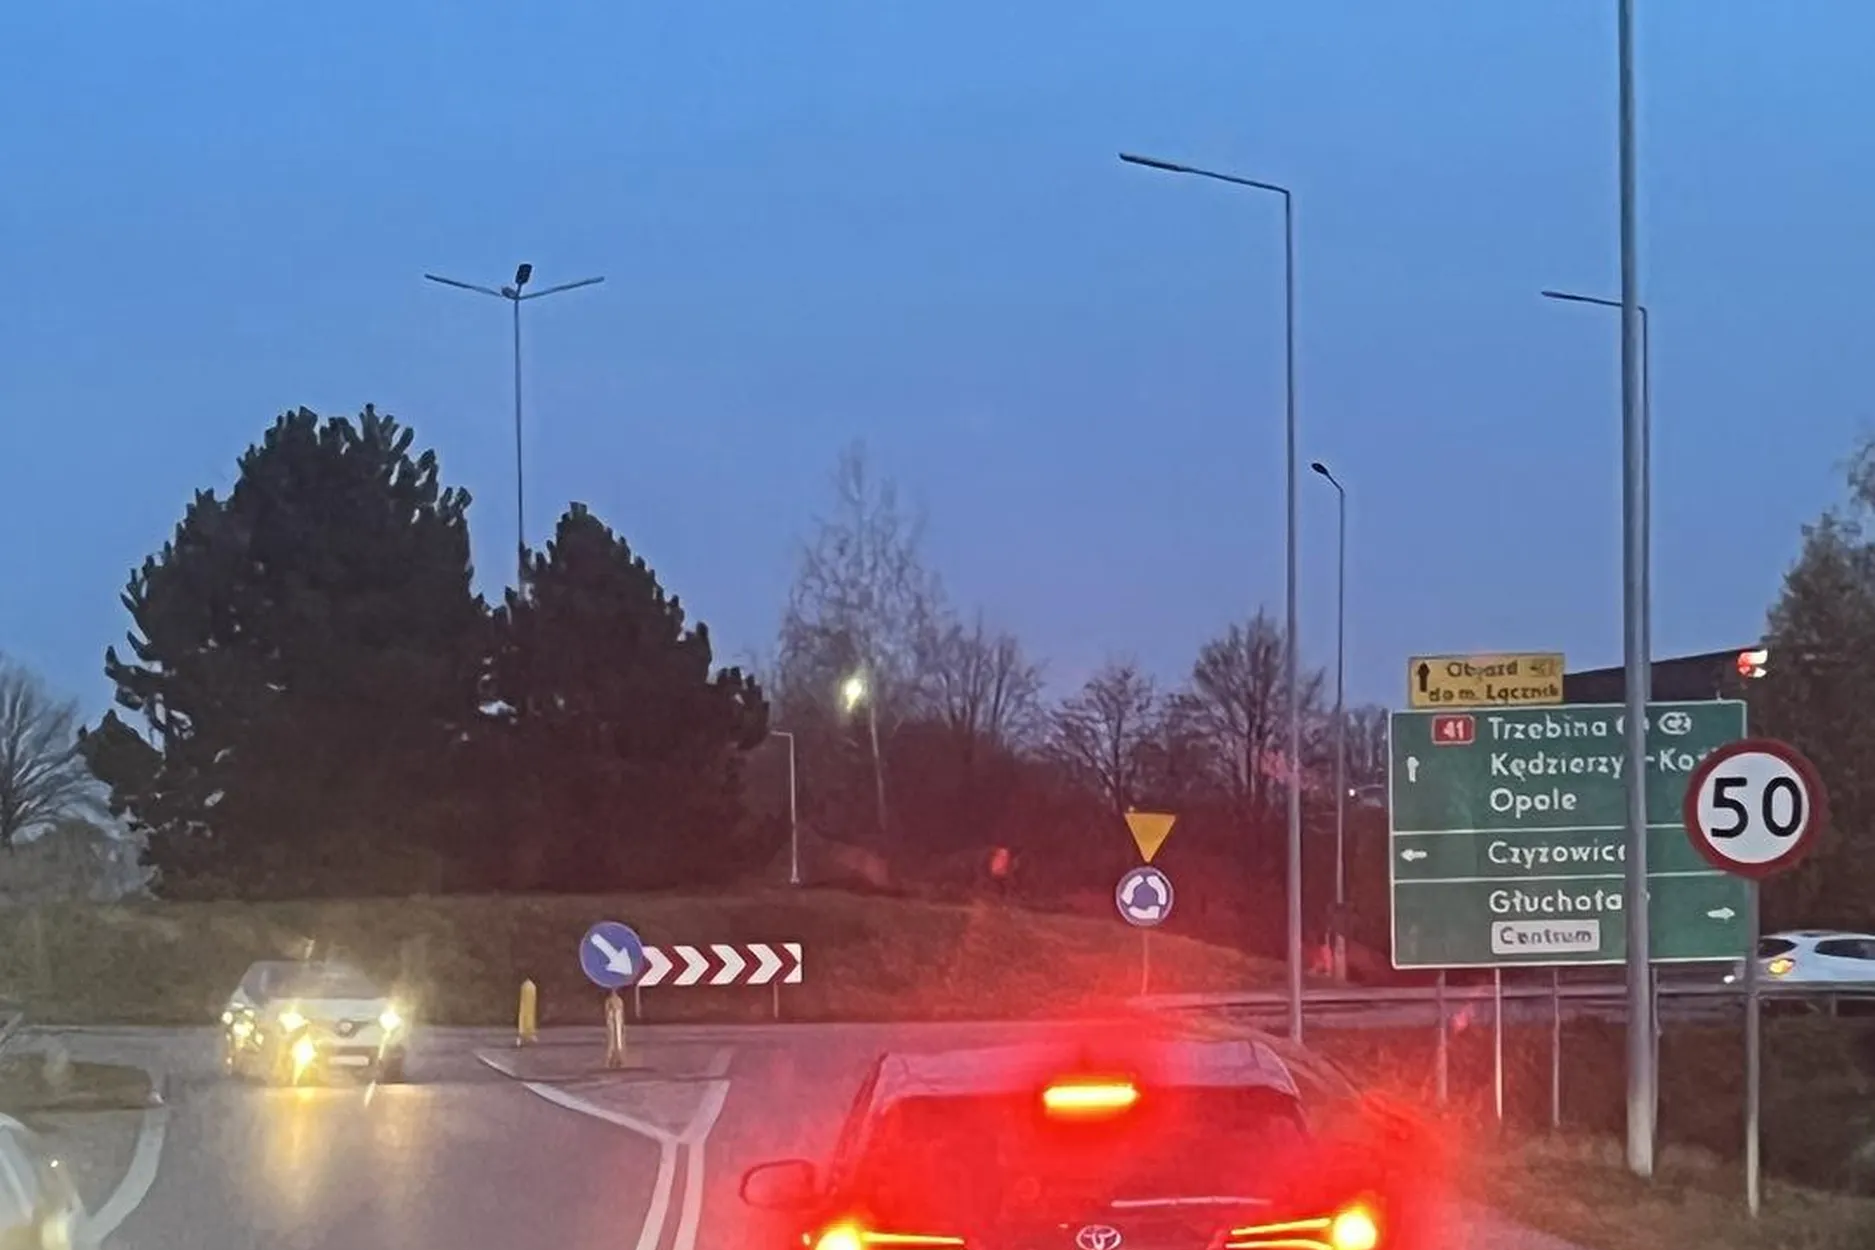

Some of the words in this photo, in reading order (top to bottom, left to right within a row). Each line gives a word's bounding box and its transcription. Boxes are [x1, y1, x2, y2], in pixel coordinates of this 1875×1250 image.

[1442, 720, 1465, 740] 41
[1490, 787, 1578, 819] Opole
[1710, 776, 1803, 838] 50
[1489, 888, 1651, 914] Głuchoła
[1499, 926, 1592, 945] Centrum
